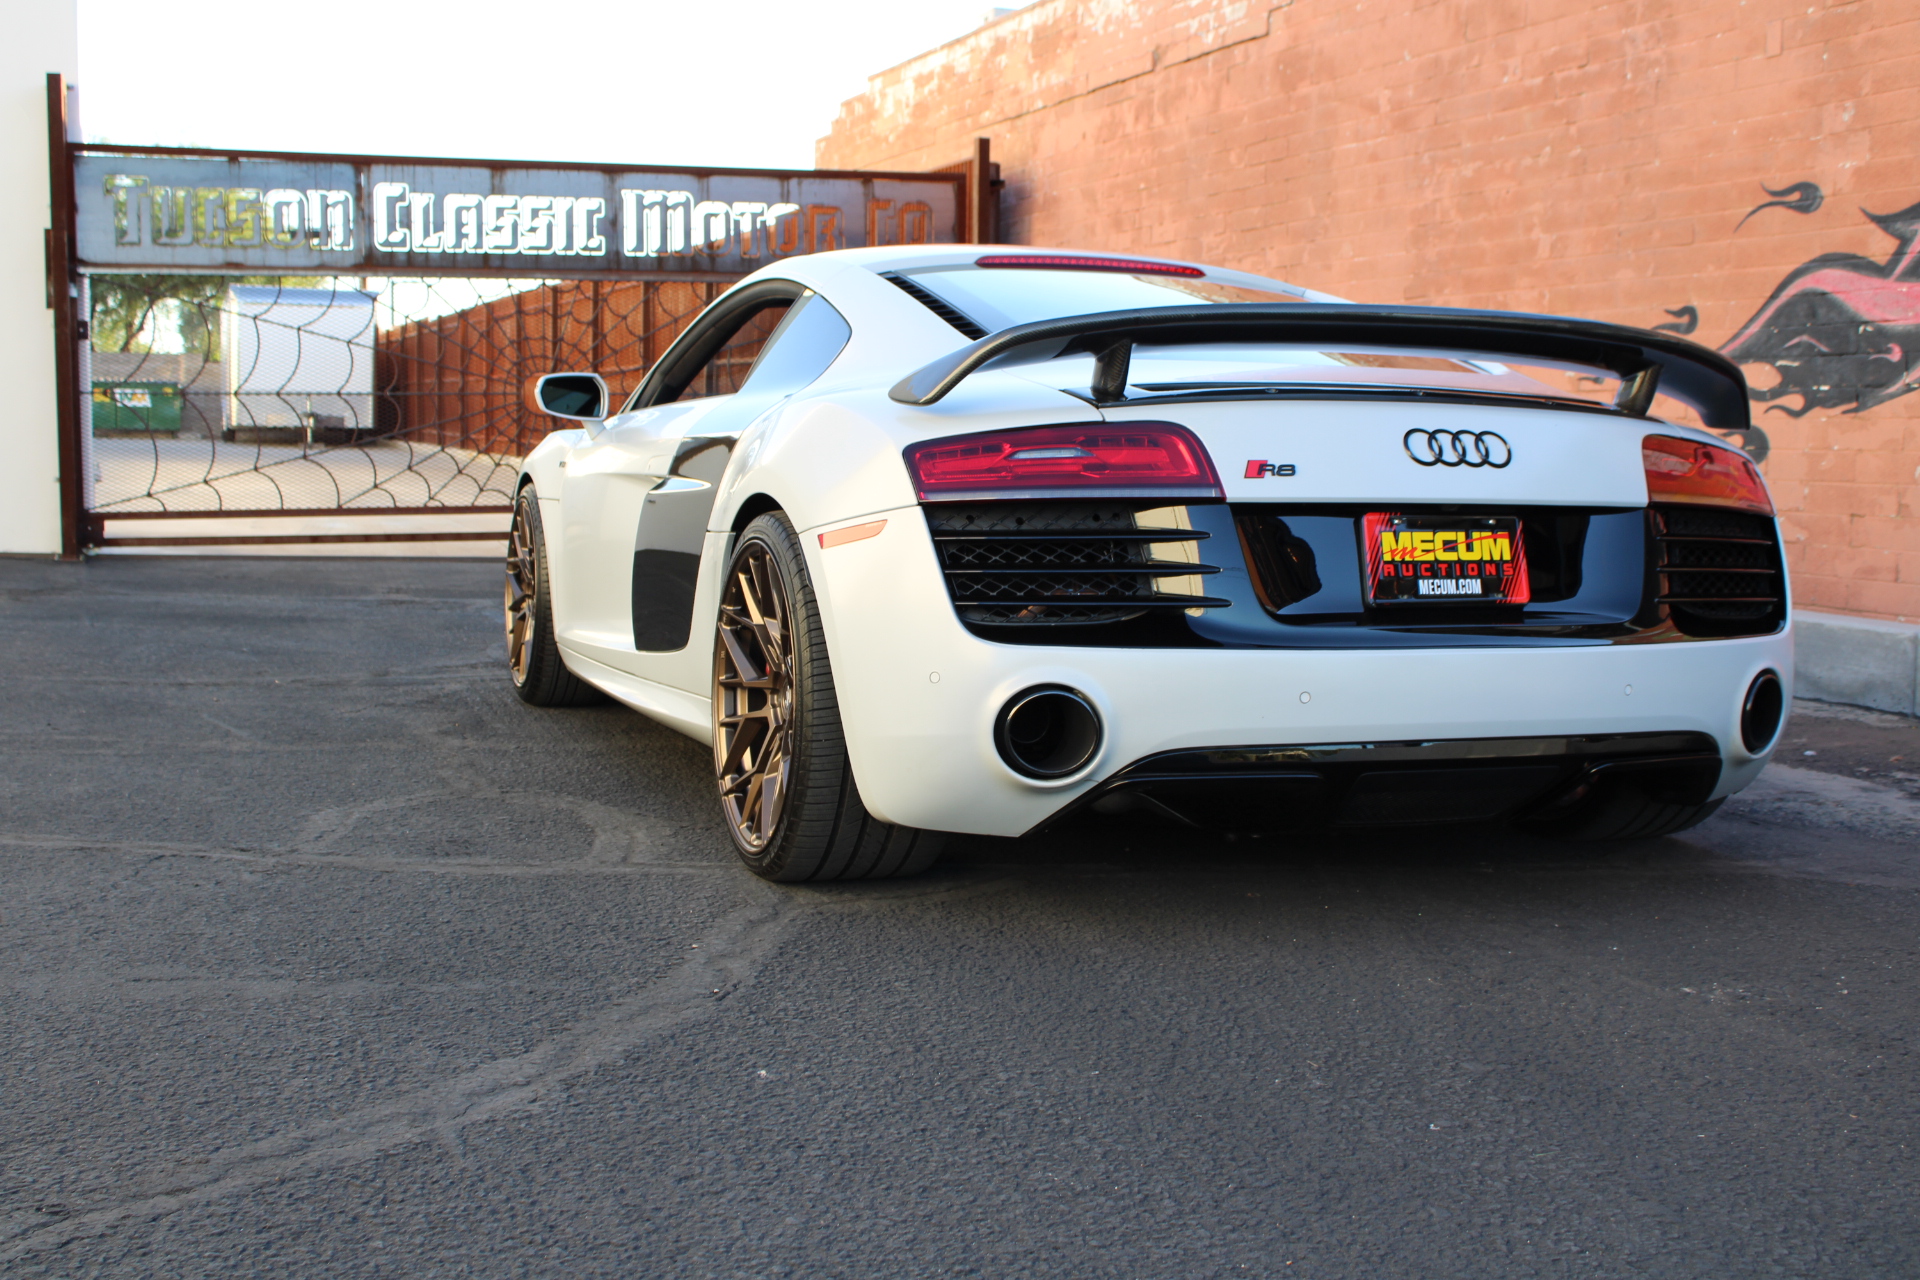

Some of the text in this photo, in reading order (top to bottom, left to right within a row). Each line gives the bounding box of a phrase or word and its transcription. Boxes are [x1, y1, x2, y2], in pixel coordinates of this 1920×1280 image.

[1257, 463, 1297, 477] R8
[1381, 531, 1512, 562] MECUM
[1383, 563, 1515, 577] AUCTIONS
[1418, 578, 1483, 595] MECUM.COM
